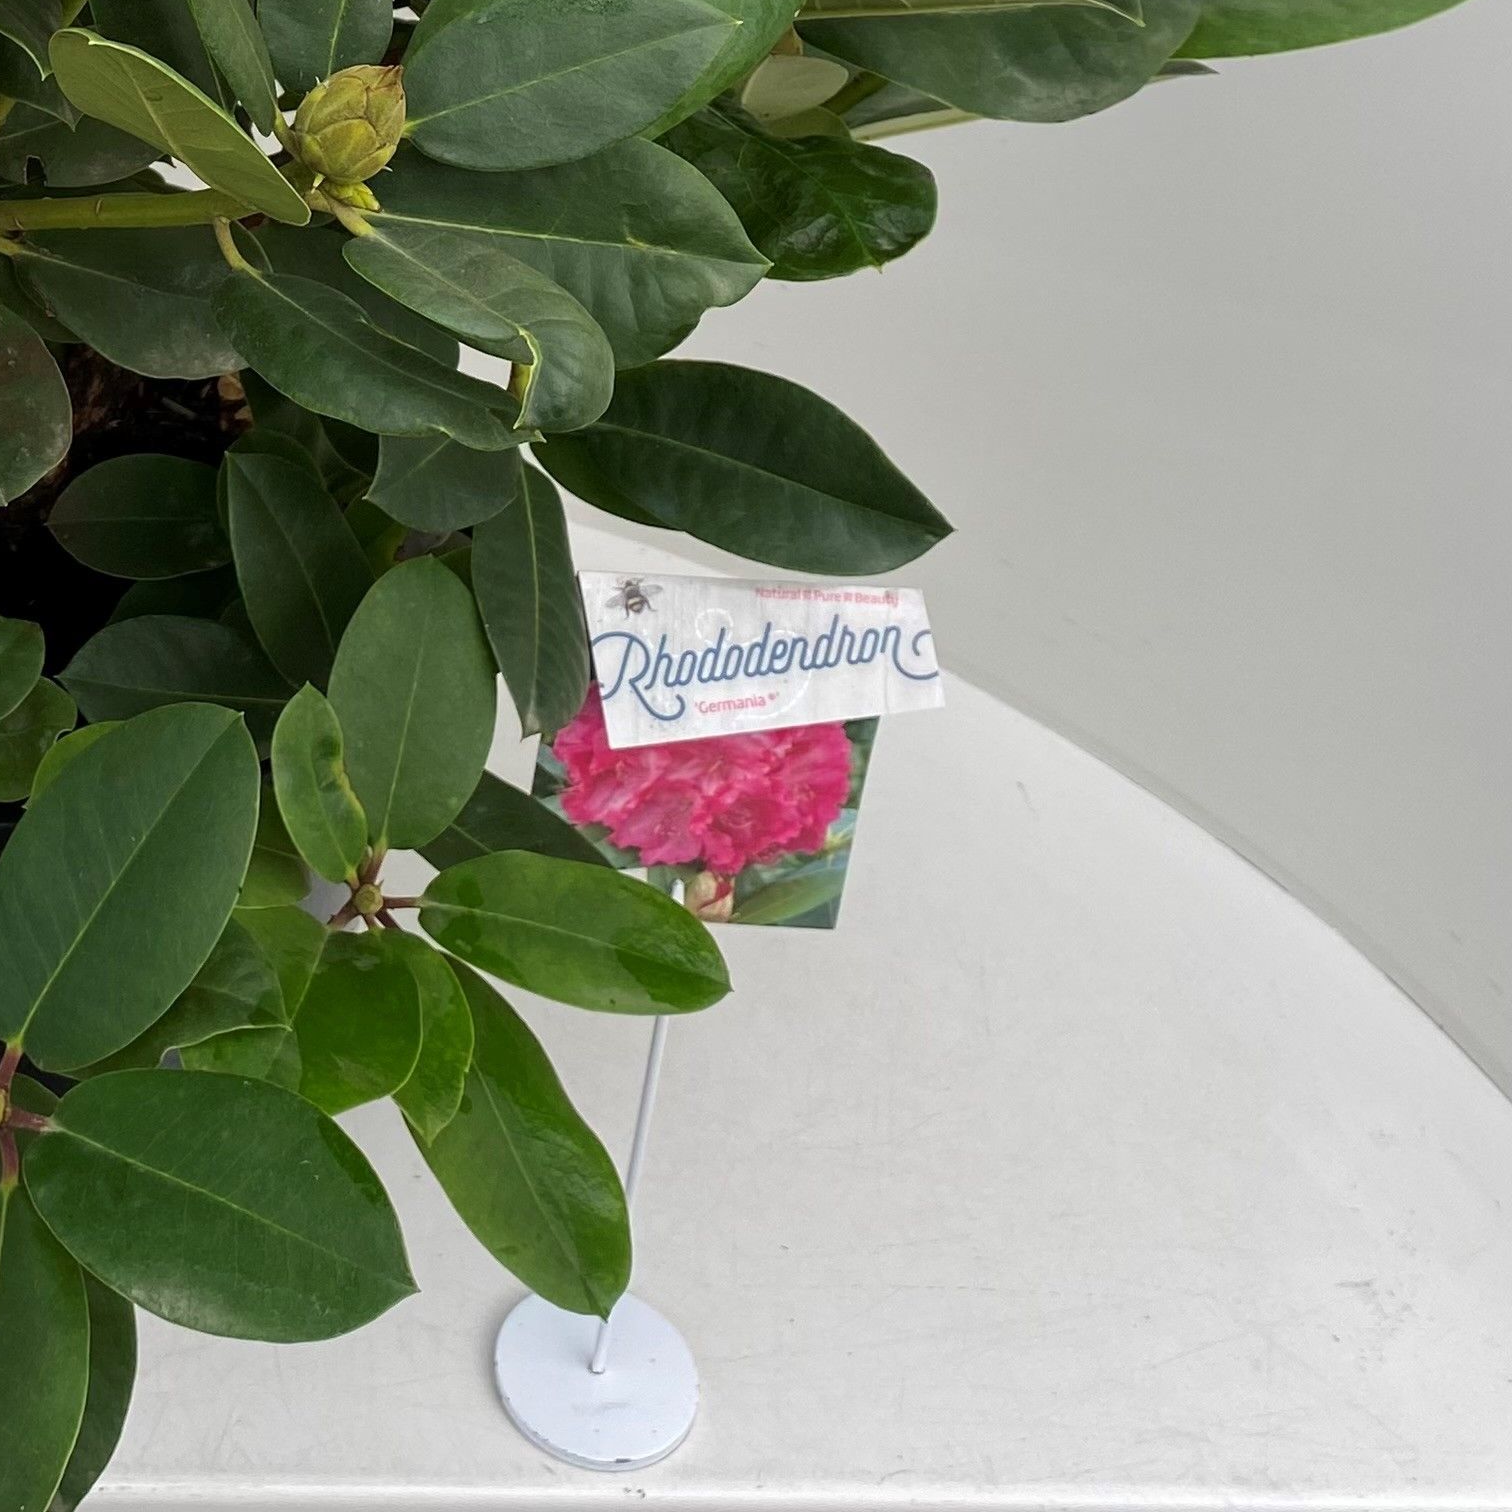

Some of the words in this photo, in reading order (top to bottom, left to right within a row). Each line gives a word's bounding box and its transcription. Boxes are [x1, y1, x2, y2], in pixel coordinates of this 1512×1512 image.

[813, 589, 841, 603] Pure
[854, 591, 900, 608] Beauty
[592, 614, 939, 721] Rhododendron
